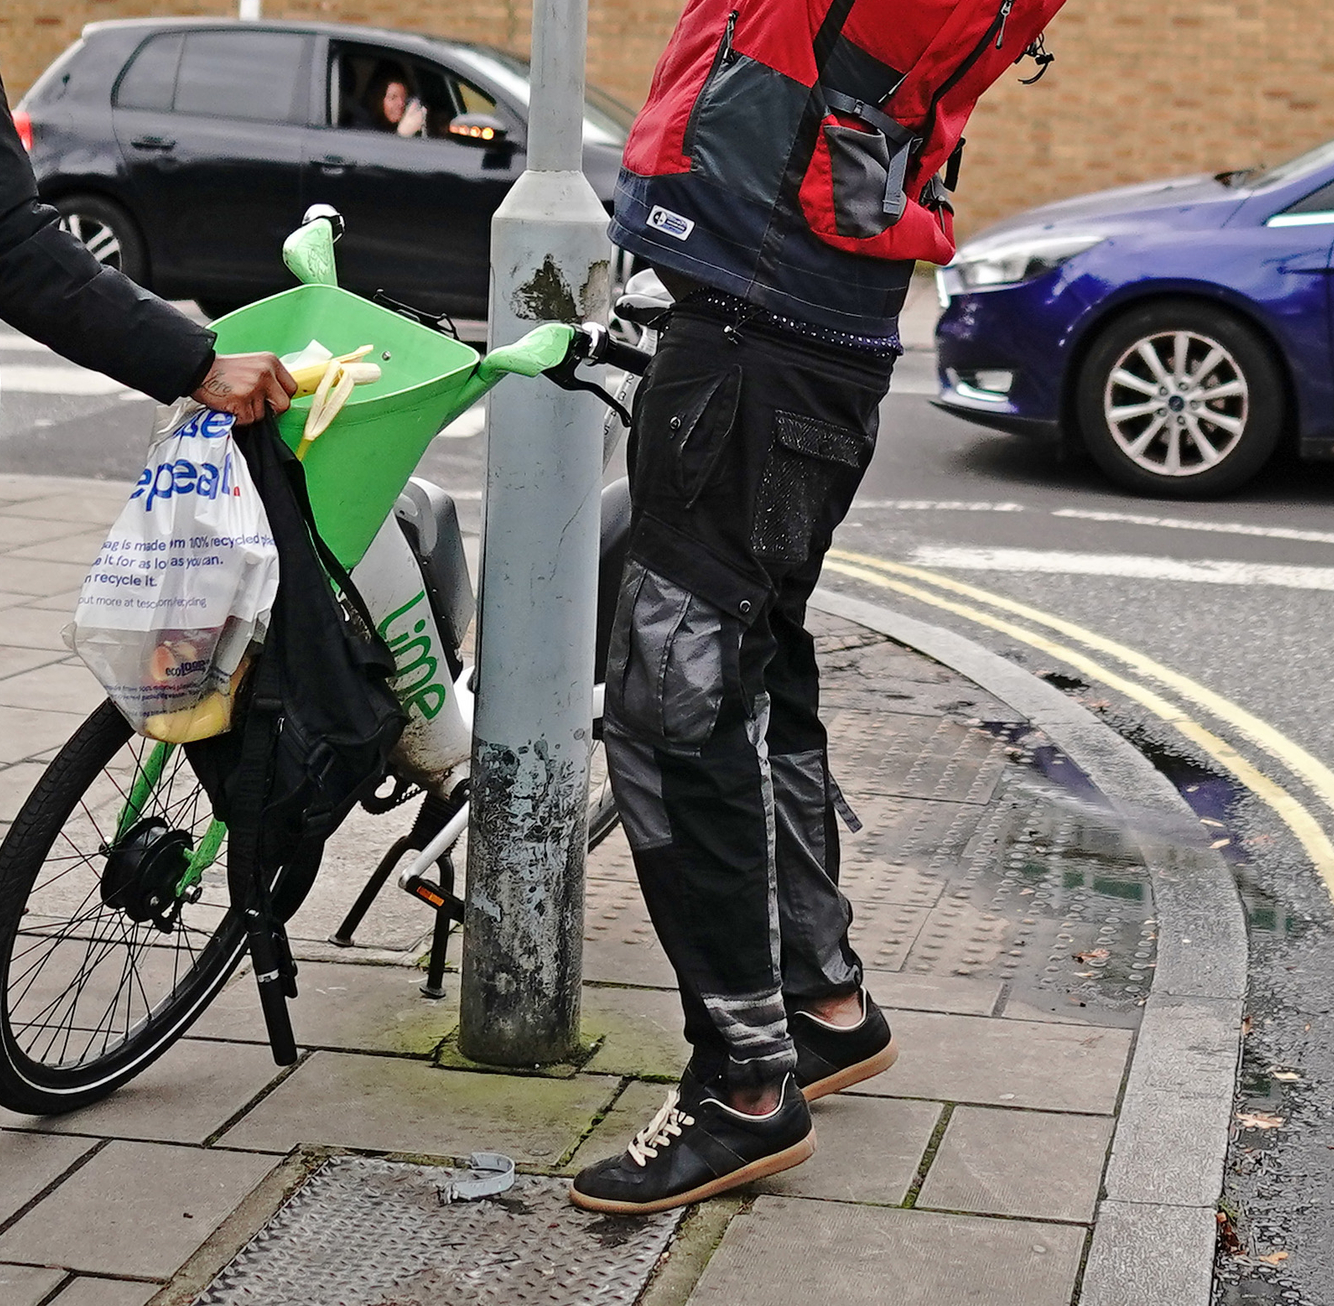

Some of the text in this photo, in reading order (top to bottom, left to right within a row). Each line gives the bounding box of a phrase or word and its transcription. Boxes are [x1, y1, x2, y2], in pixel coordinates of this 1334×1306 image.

[121, 539, 132, 550] is
[134, 539, 167, 552] made
[116, 555, 137, 568] for
[138, 560, 152, 570] as
[170, 557, 185, 567] as
[94, 574, 142, 588] recycle
[96, 597, 122, 606] more
[124, 598, 135, 608] at
[376, 589, 446, 720] Lime
